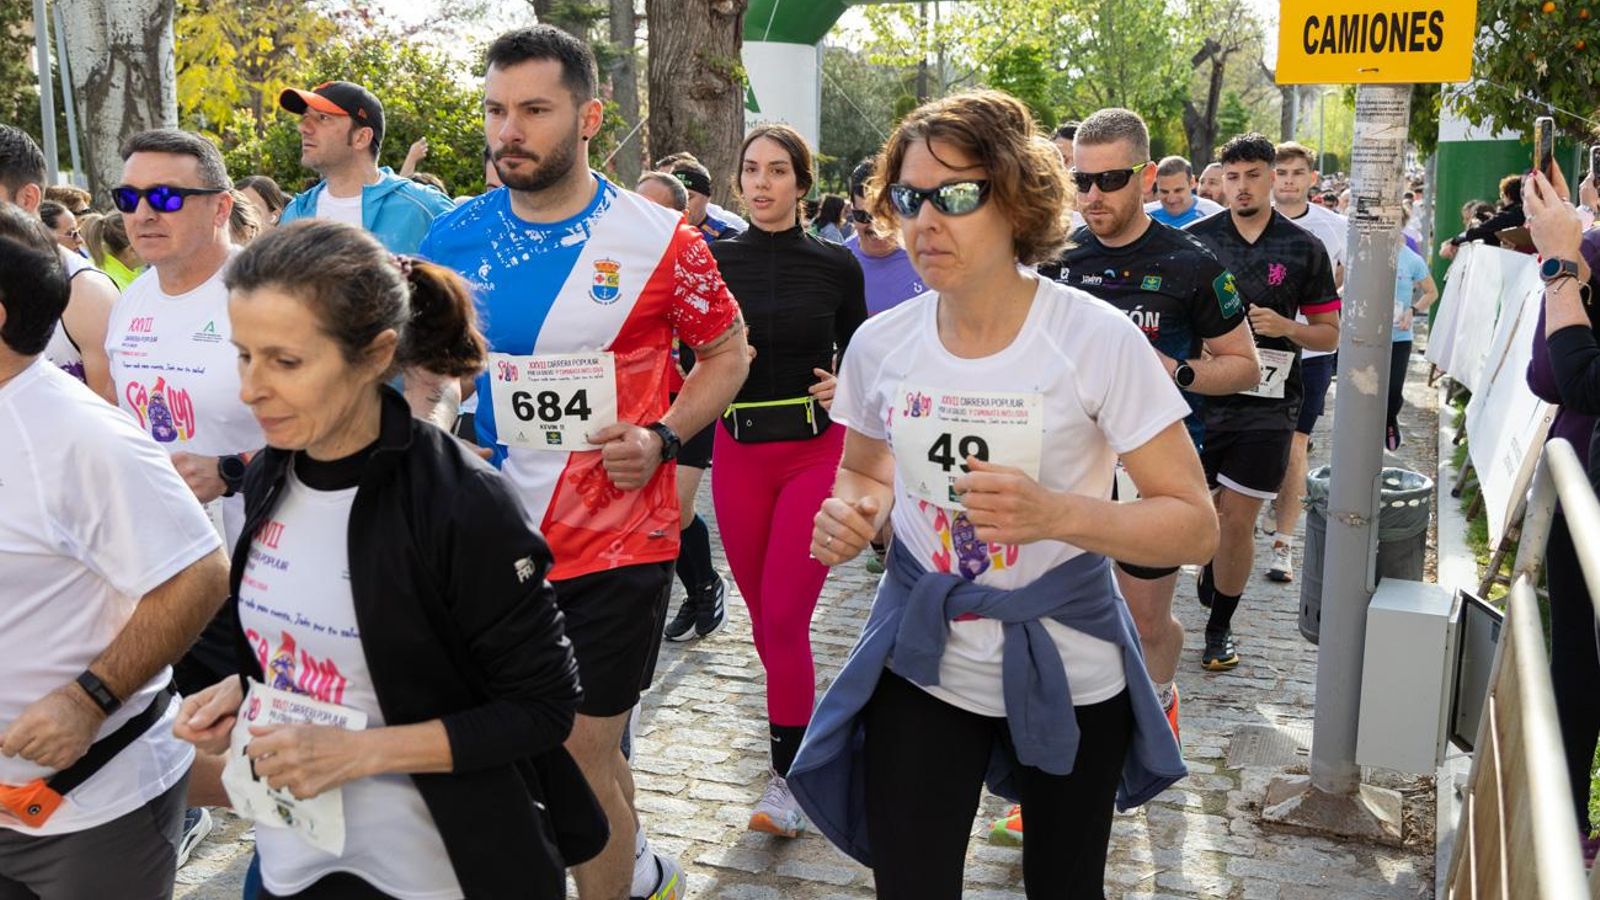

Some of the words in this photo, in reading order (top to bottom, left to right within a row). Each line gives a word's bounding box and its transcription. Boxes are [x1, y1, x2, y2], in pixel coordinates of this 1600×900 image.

[1303, 10, 1444, 55] CAMIONES
[512, 389, 592, 422] 684
[928, 433, 989, 474] 49
